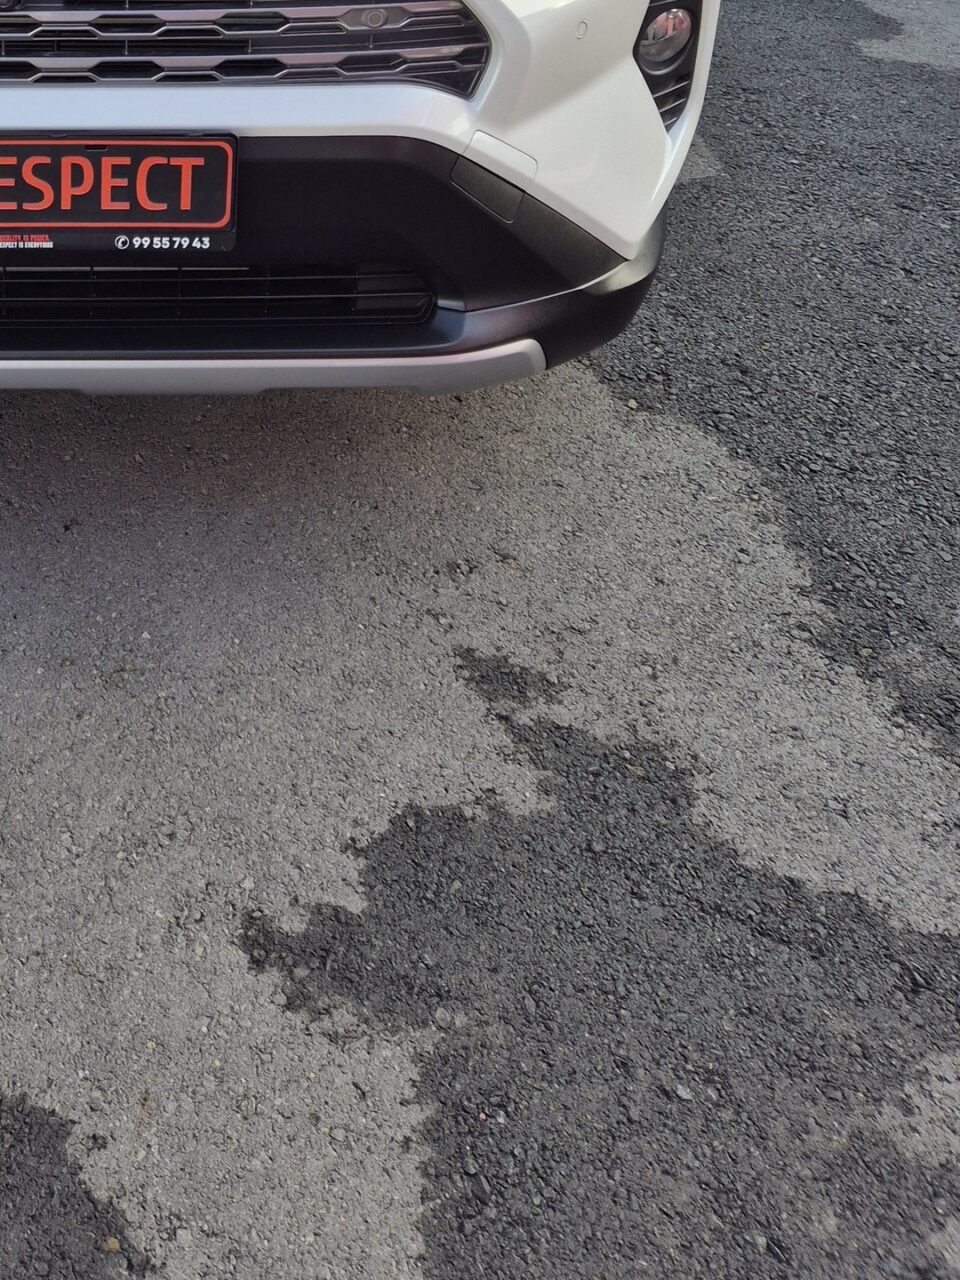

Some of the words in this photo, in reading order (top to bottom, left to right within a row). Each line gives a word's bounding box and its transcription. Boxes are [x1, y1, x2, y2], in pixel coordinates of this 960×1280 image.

[132, 236, 149, 249] 99
[152, 236, 170, 249] 55
[172, 236, 190, 249] 79
[192, 236, 210, 249] 43
